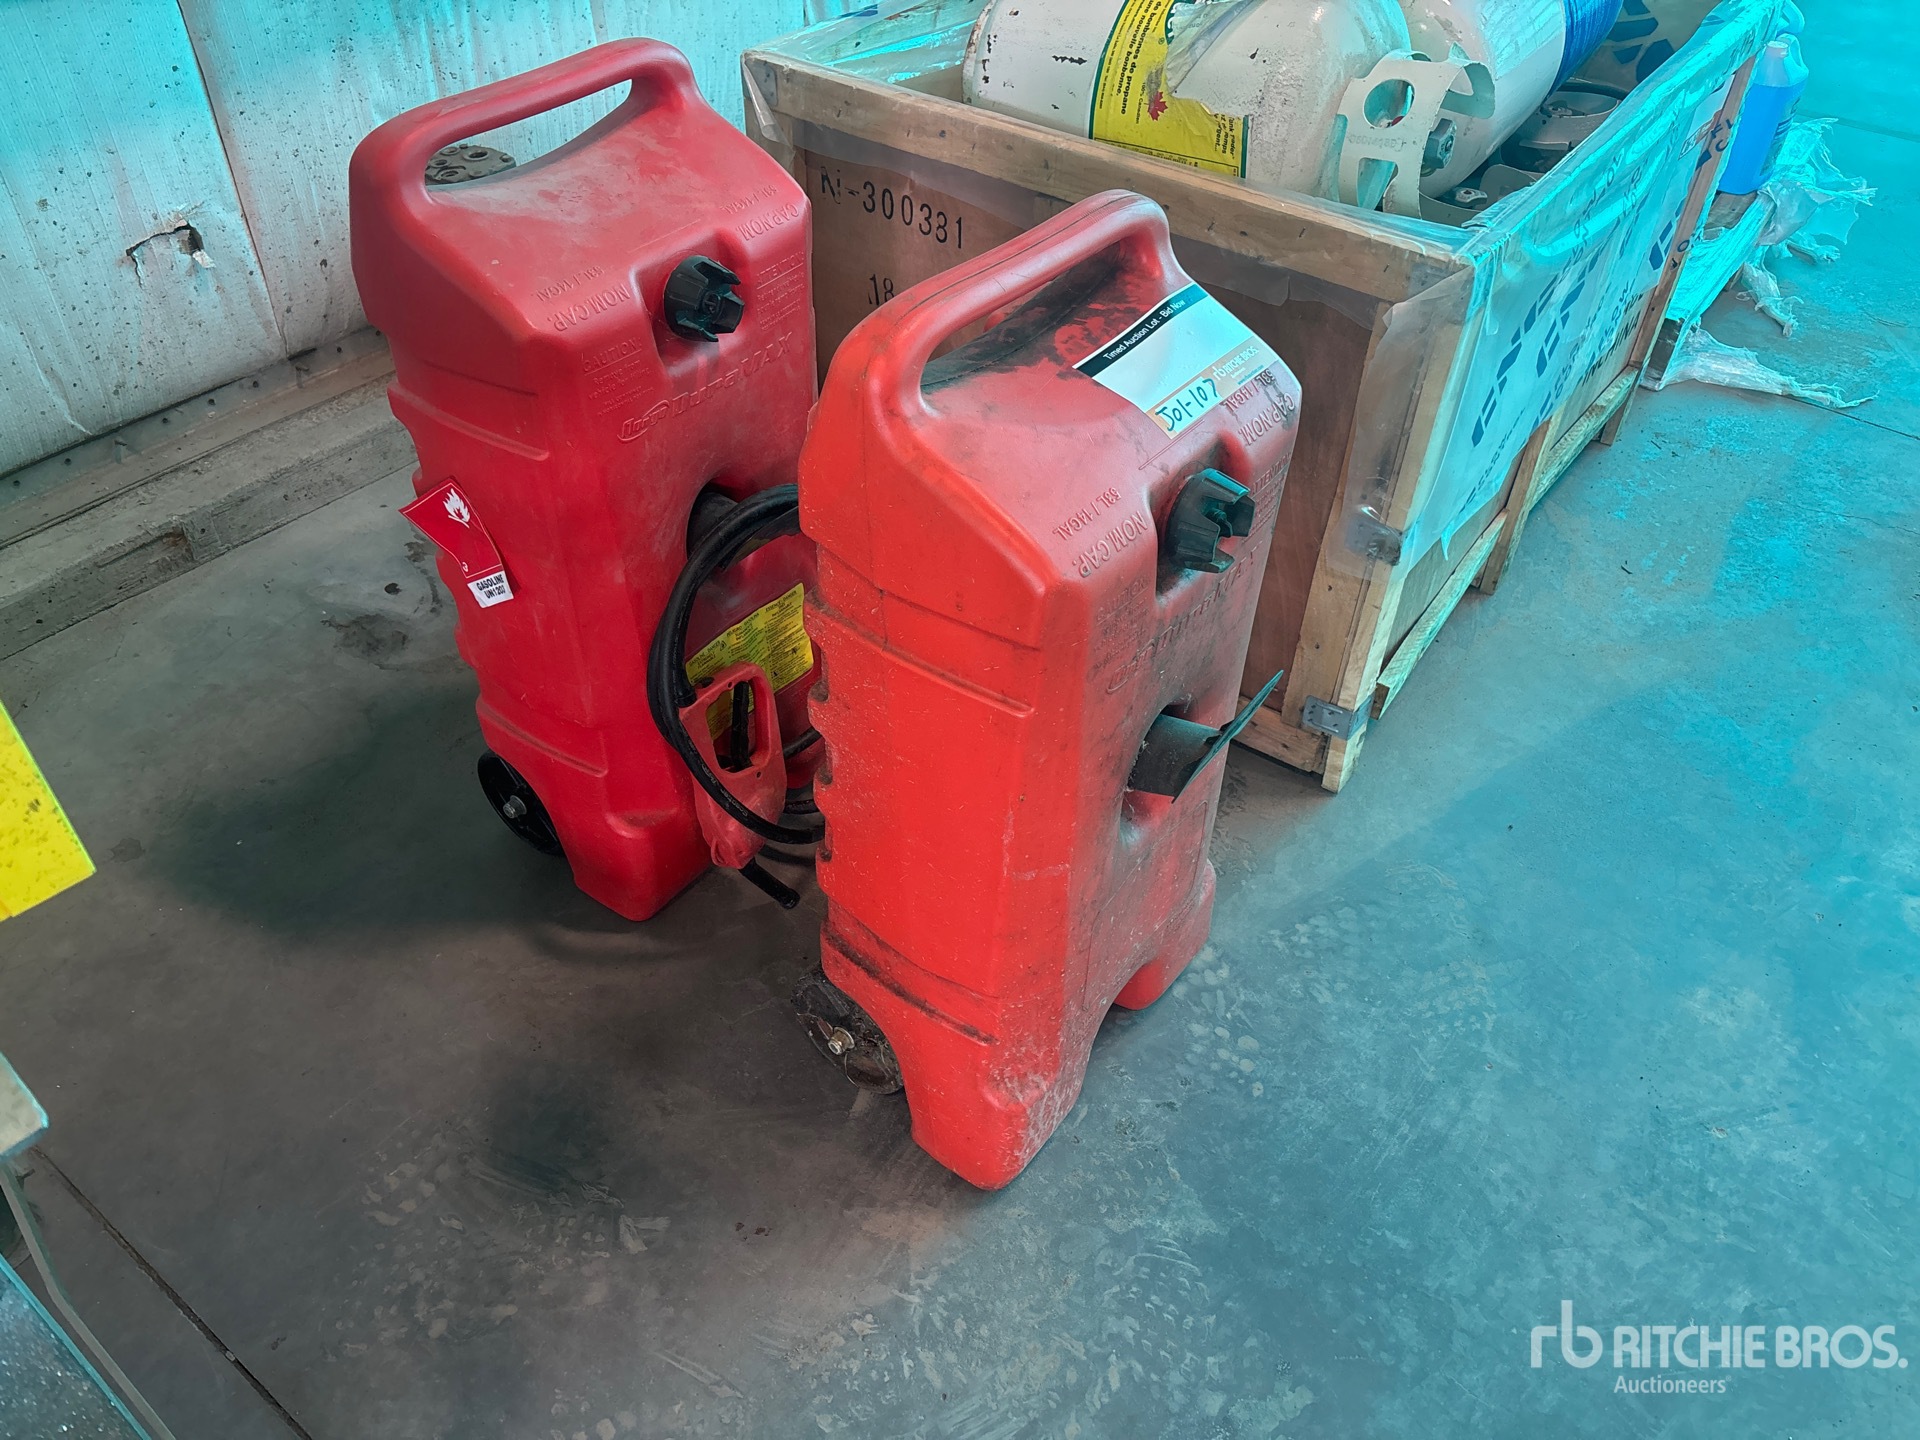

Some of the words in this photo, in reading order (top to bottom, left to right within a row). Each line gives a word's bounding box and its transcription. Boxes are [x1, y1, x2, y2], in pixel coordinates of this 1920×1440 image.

[1129, 15, 1146, 49] nouvelle
[1133, 12, 1157, 60] bonbonnes
[1129, 61, 1137, 74] de
[1121, 75, 1133, 115] propane
[1103, 343, 1127, 360] Timed
[1123, 327, 1150, 347] Auction
[1145, 318, 1160, 329] Lot
[1159, 306, 1174, 318] Bid
[1170, 299, 1186, 311] Now
[1098, 486, 1122, 510] 53L
[1052, 507, 1095, 541] 14GAL
[461, 561, 469, 573] 3
[476, 574, 505, 591] GASOLINE
